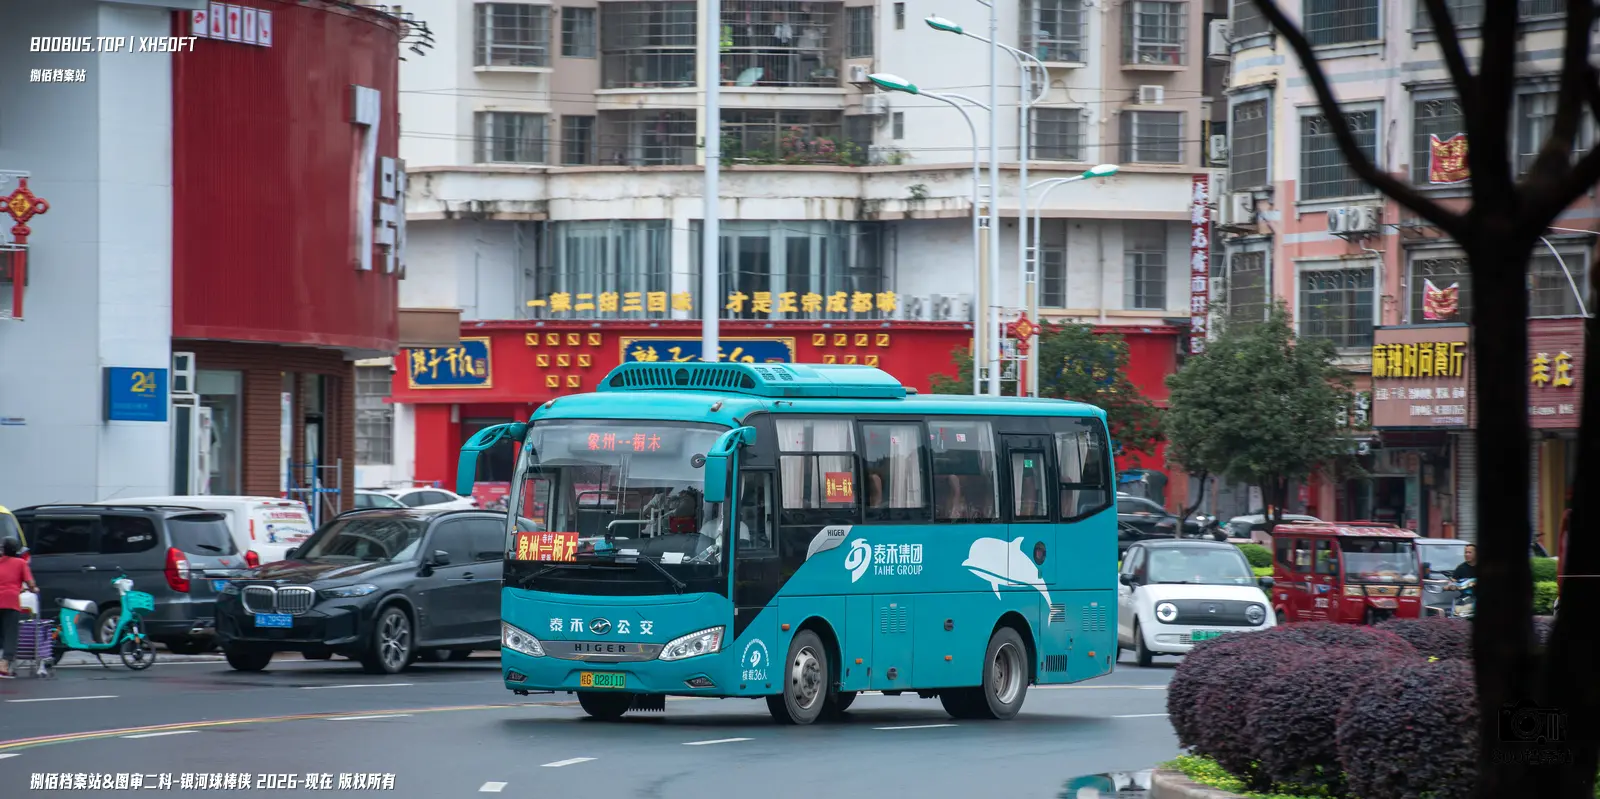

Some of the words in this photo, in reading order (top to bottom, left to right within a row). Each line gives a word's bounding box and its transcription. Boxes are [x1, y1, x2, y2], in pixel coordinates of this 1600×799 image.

[726, 291, 897, 313] 才是正宗成都味
[1371, 341, 1466, 378] 麻辣时尚餐厅
[129, 371, 157, 393] 24
[827, 529, 845, 537] HIGER
[874, 544, 923, 564] 泰禾集团
[874, 565, 894, 576] TAIHE
[896, 565, 923, 576] GROUP
[549, 617, 584, 633] 泰禾
[617, 619, 654, 636] 公交
[574, 643, 627, 653] HIGER
[742, 669, 768, 681] 核载36人
